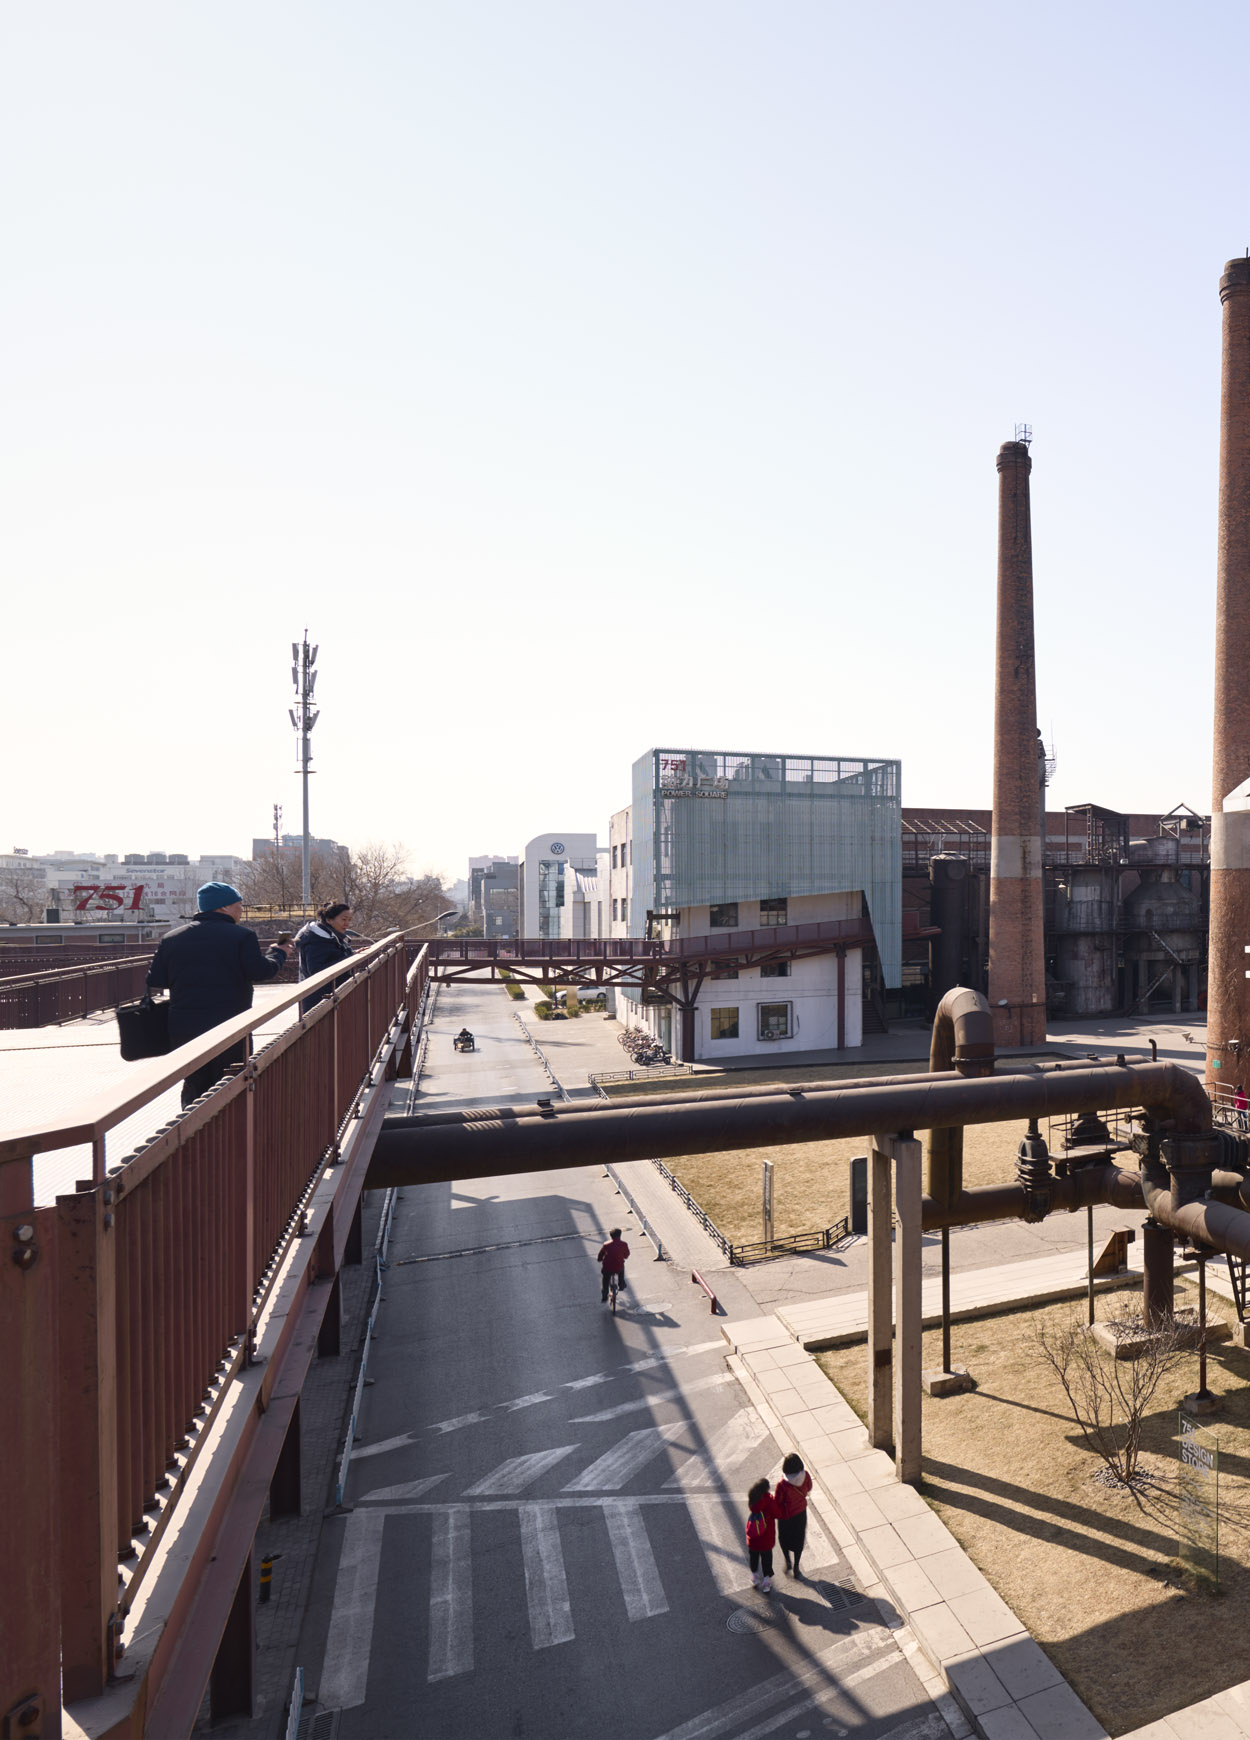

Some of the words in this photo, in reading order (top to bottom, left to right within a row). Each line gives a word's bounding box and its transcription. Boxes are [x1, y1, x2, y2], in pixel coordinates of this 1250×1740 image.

[660, 759, 687, 771] 751
[695, 790, 728, 799] SQUARE
[73, 885, 144, 911] 751
[1182, 1420, 1196, 1440] 751
[1182, 1434, 1213, 1468] DESIGN
